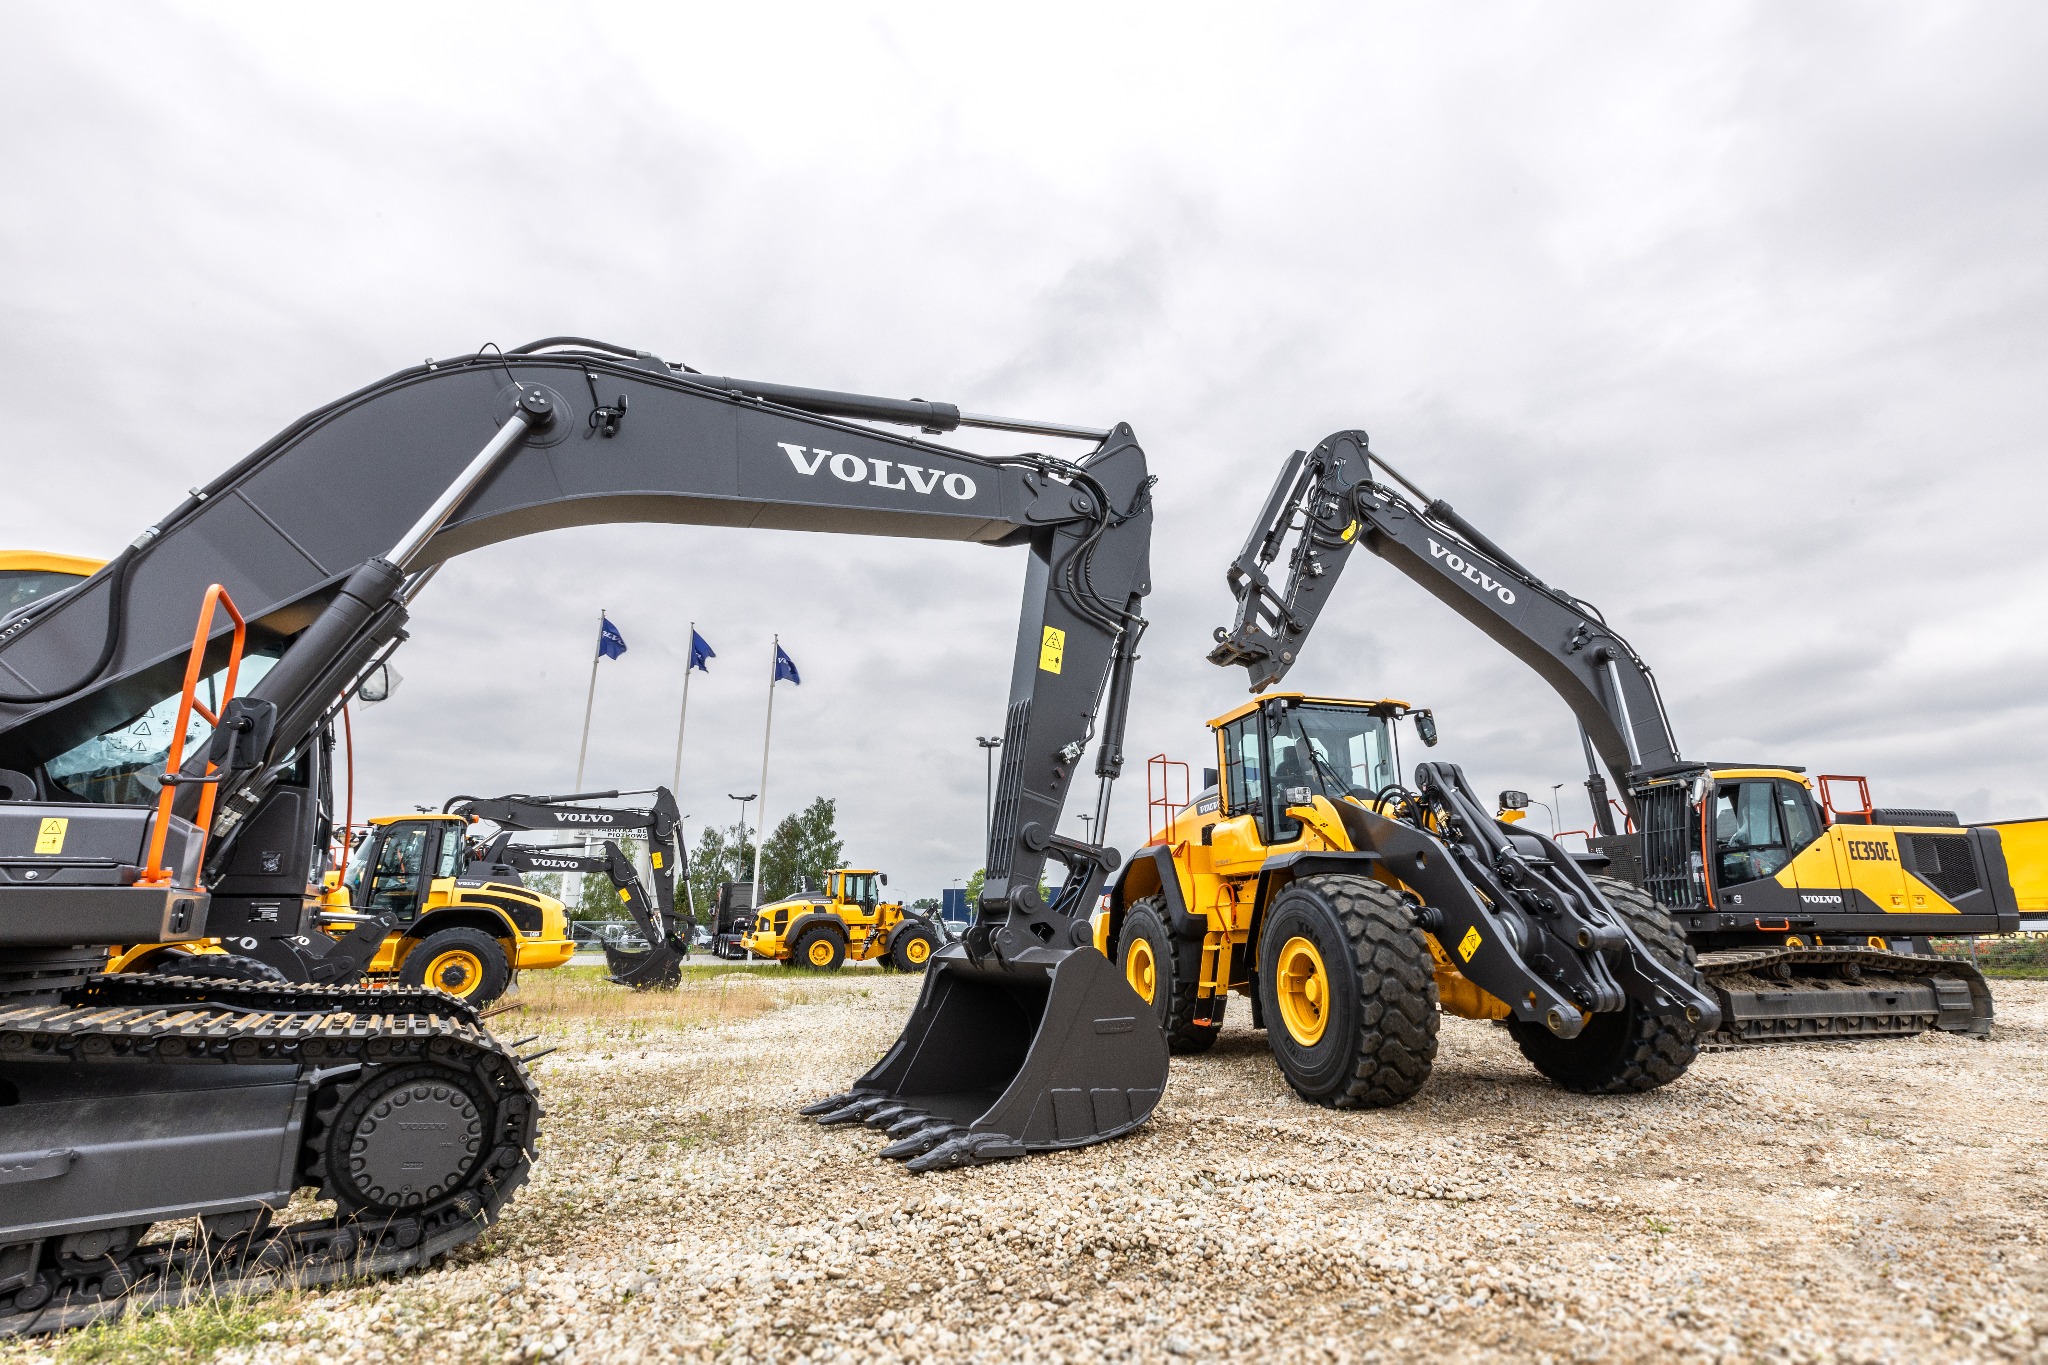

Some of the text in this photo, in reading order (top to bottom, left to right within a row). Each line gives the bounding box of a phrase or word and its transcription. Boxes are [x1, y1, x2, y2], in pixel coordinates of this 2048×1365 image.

[777, 442, 977, 500] VOLVO
[1427, 538, 1516, 605] VOLVO
[1200, 801, 1219, 814] VOLV
[554, 812, 614, 823] VOLVO
[530, 858, 579, 869] VOLVO
[1801, 895, 1842, 904] VOLVO
[399, 1122, 448, 1130] VOLVO
